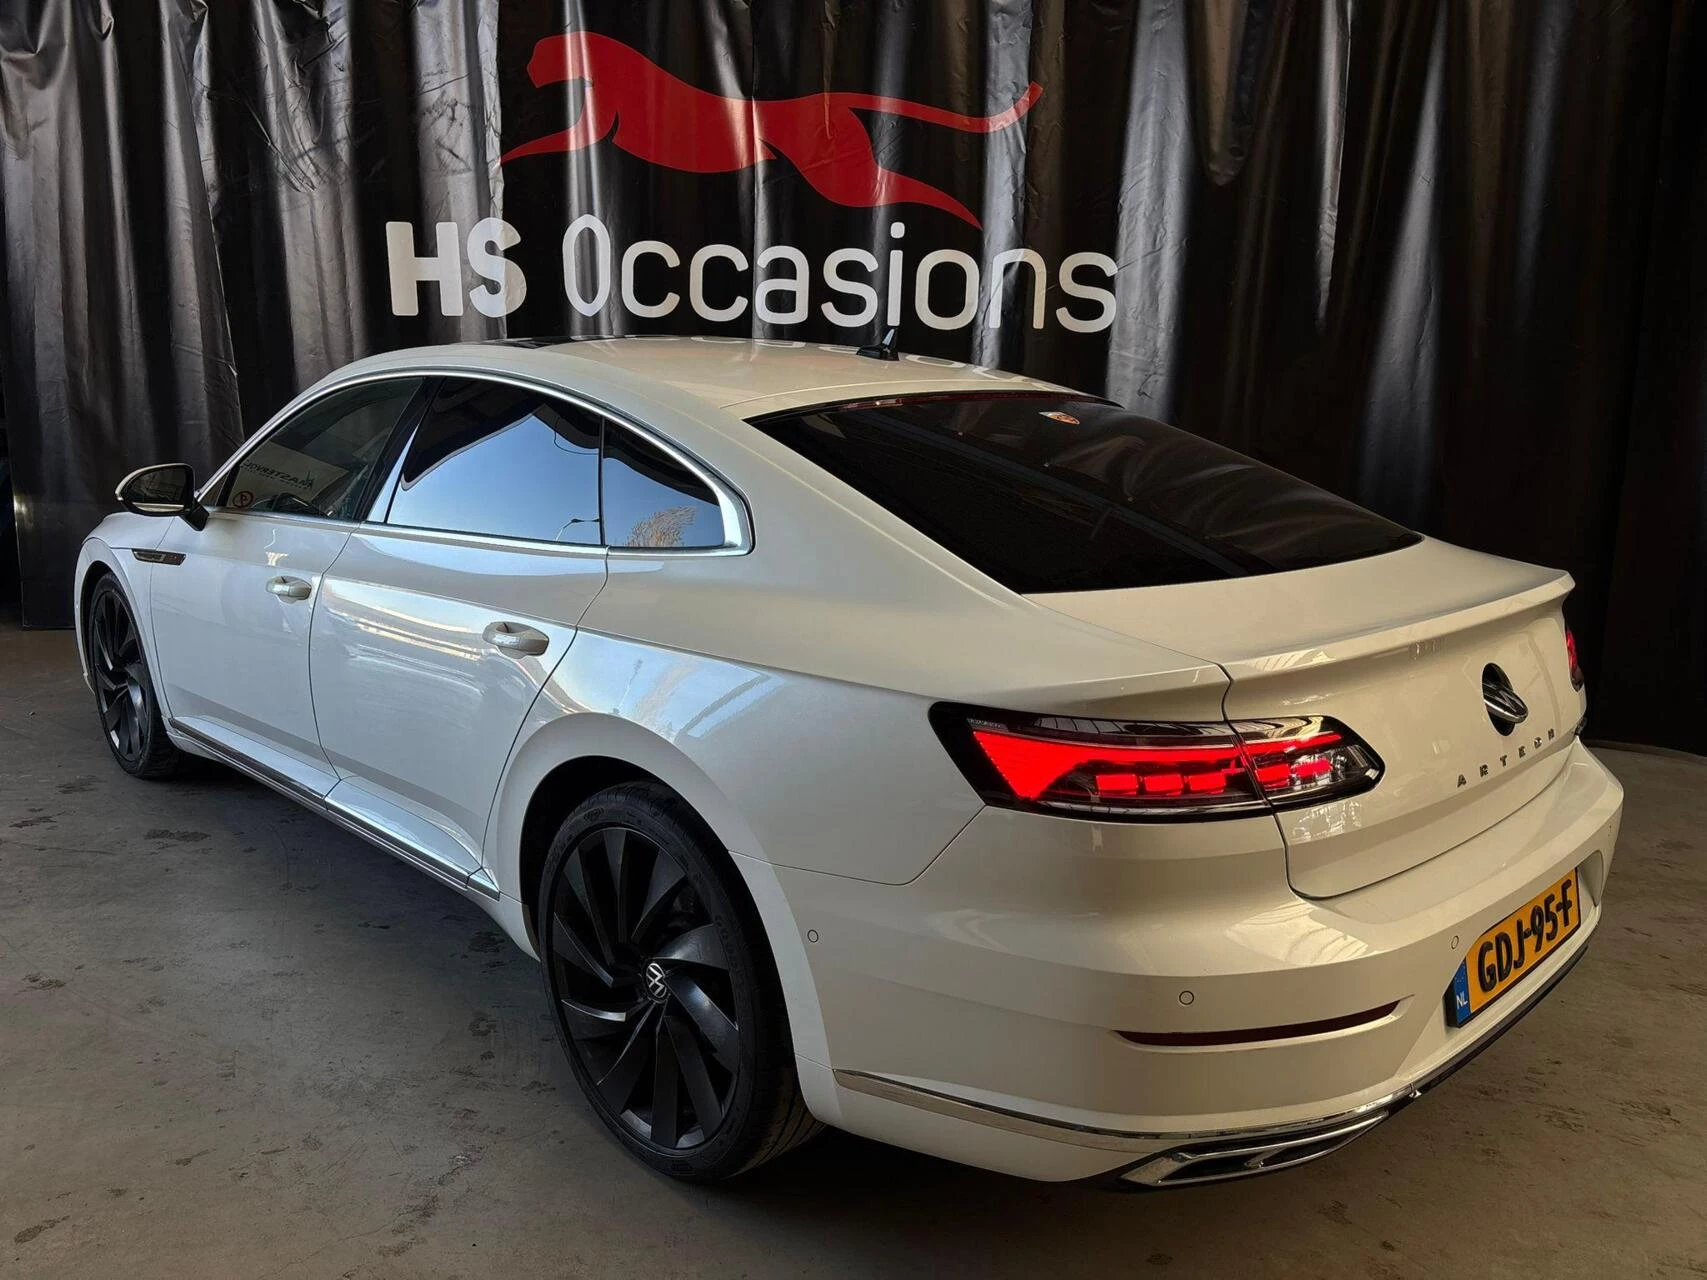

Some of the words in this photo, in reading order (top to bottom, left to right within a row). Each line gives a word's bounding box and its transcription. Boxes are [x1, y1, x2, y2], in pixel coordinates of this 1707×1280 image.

[385, 217, 528, 318] HS
[562, 213, 1118, 333] Occasions
[1457, 728, 1555, 788] ARTEON
[1477, 878, 1573, 993] GDJ-95-F
[1456, 991, 1468, 1010] NL
